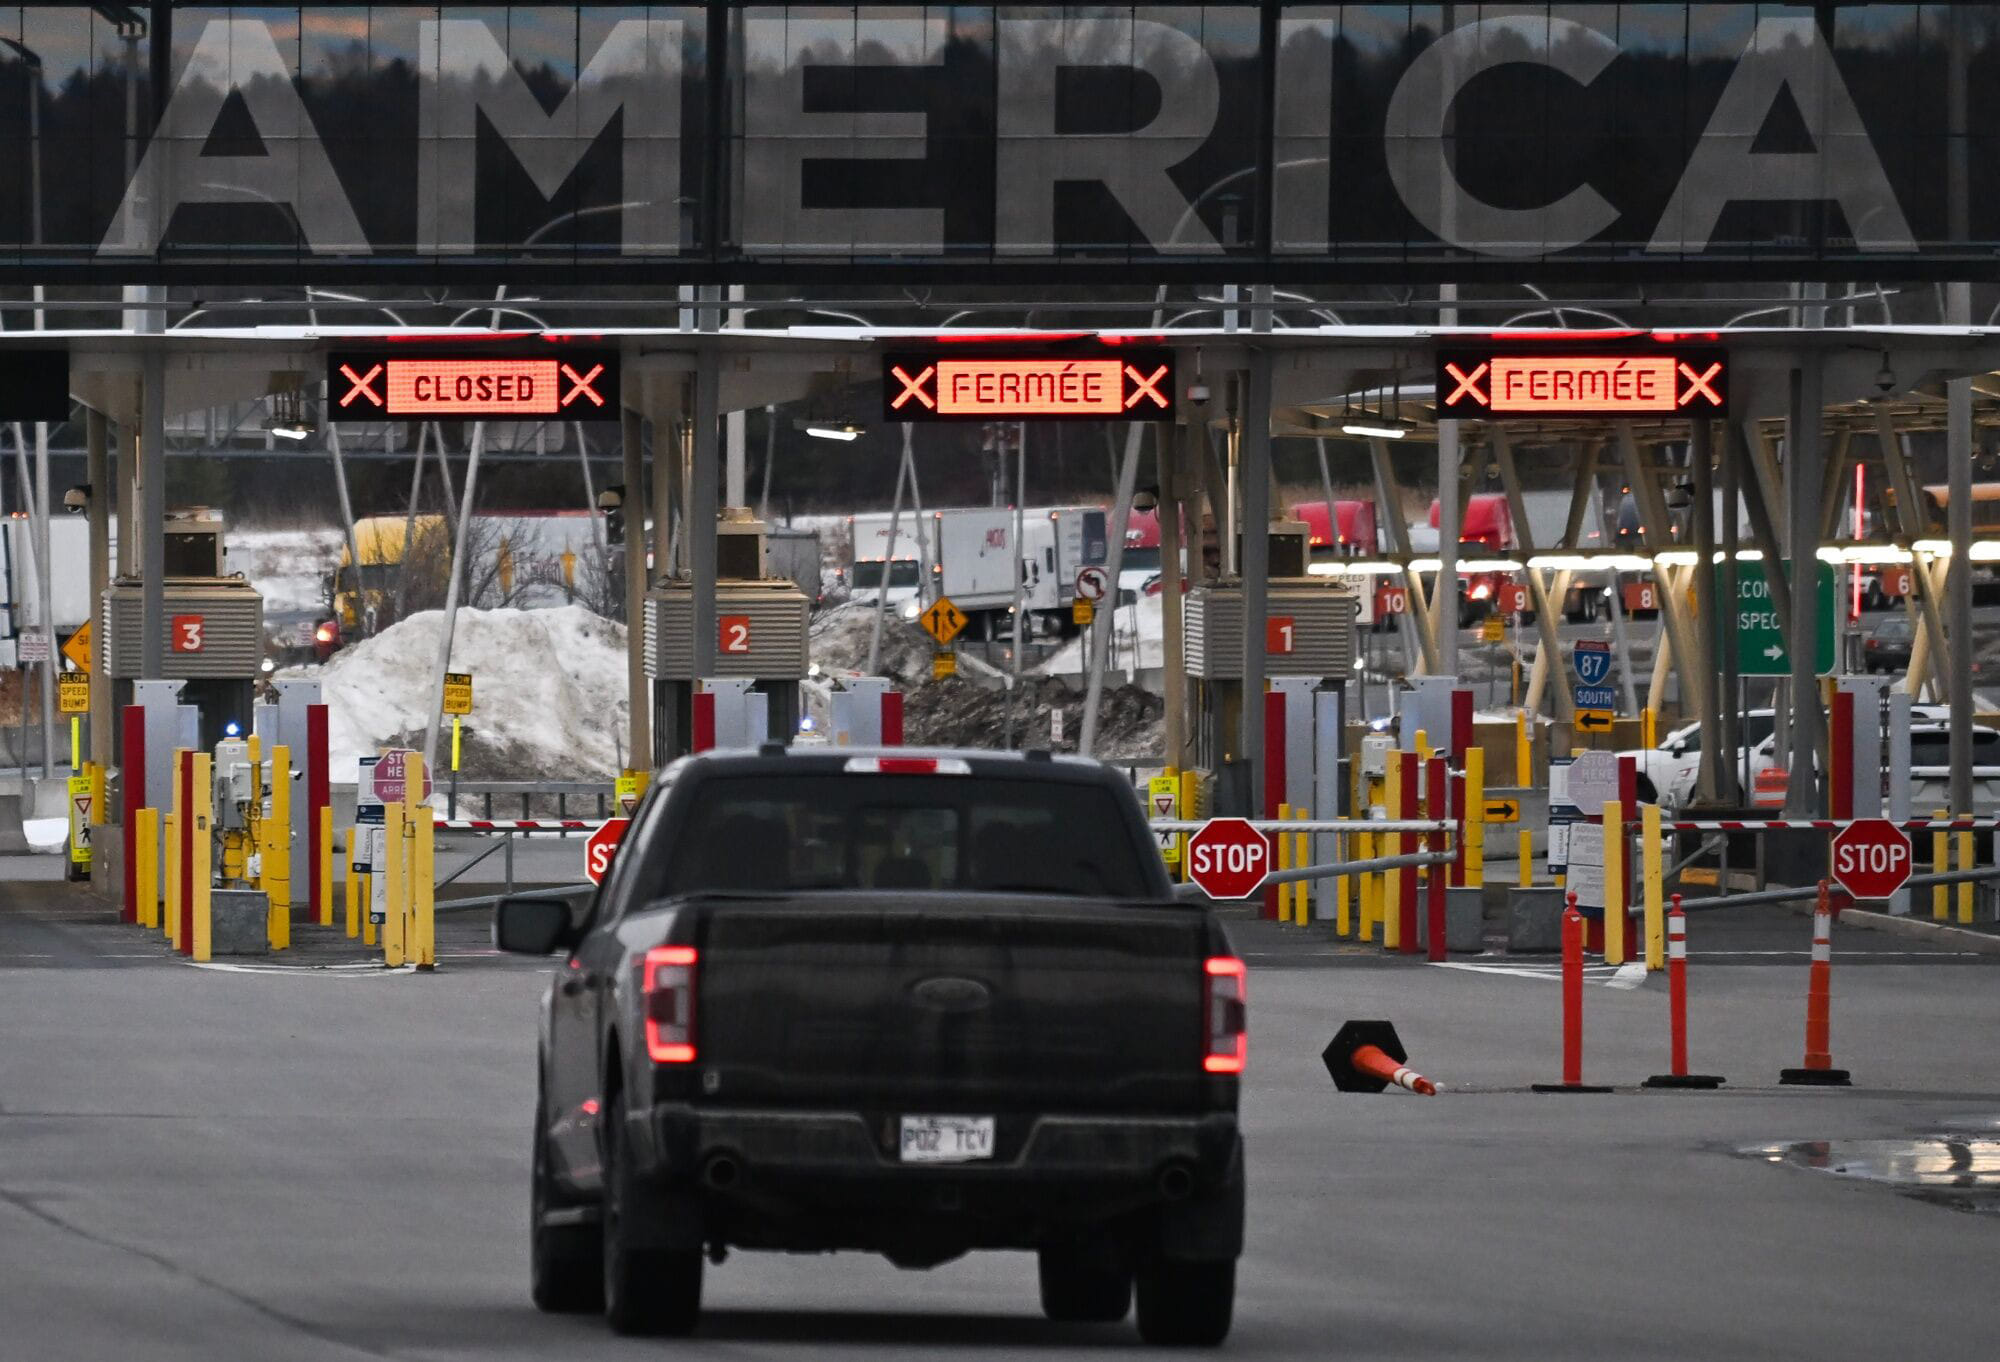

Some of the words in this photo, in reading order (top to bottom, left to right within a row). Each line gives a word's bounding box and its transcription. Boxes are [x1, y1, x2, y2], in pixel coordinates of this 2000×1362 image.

[95, 15, 1921, 257] AMERICA
[414, 375, 534, 401] CLOSED
[953, 363, 1102, 403] FERMÉE
[1506, 360, 1656, 400] FERMÉE
[1339, 574, 1365, 582] PEED
[1898, 575, 1909, 594] 6
[1383, 594, 1404, 612] 10
[1514, 591, 1525, 610] 9
[1641, 589, 1652, 608] 8
[182, 624, 200, 650] 3
[728, 624, 747, 651] 2
[1280, 626, 1292, 652] 1
[1581, 655, 1603, 677] 87
[62, 686, 87, 696] SPEED
[1577, 690, 1612, 705] SOUTH
[62, 699, 87, 708] BUMP
[1194, 844, 1263, 873] STOP
[1837, 844, 1906, 873] STOP
